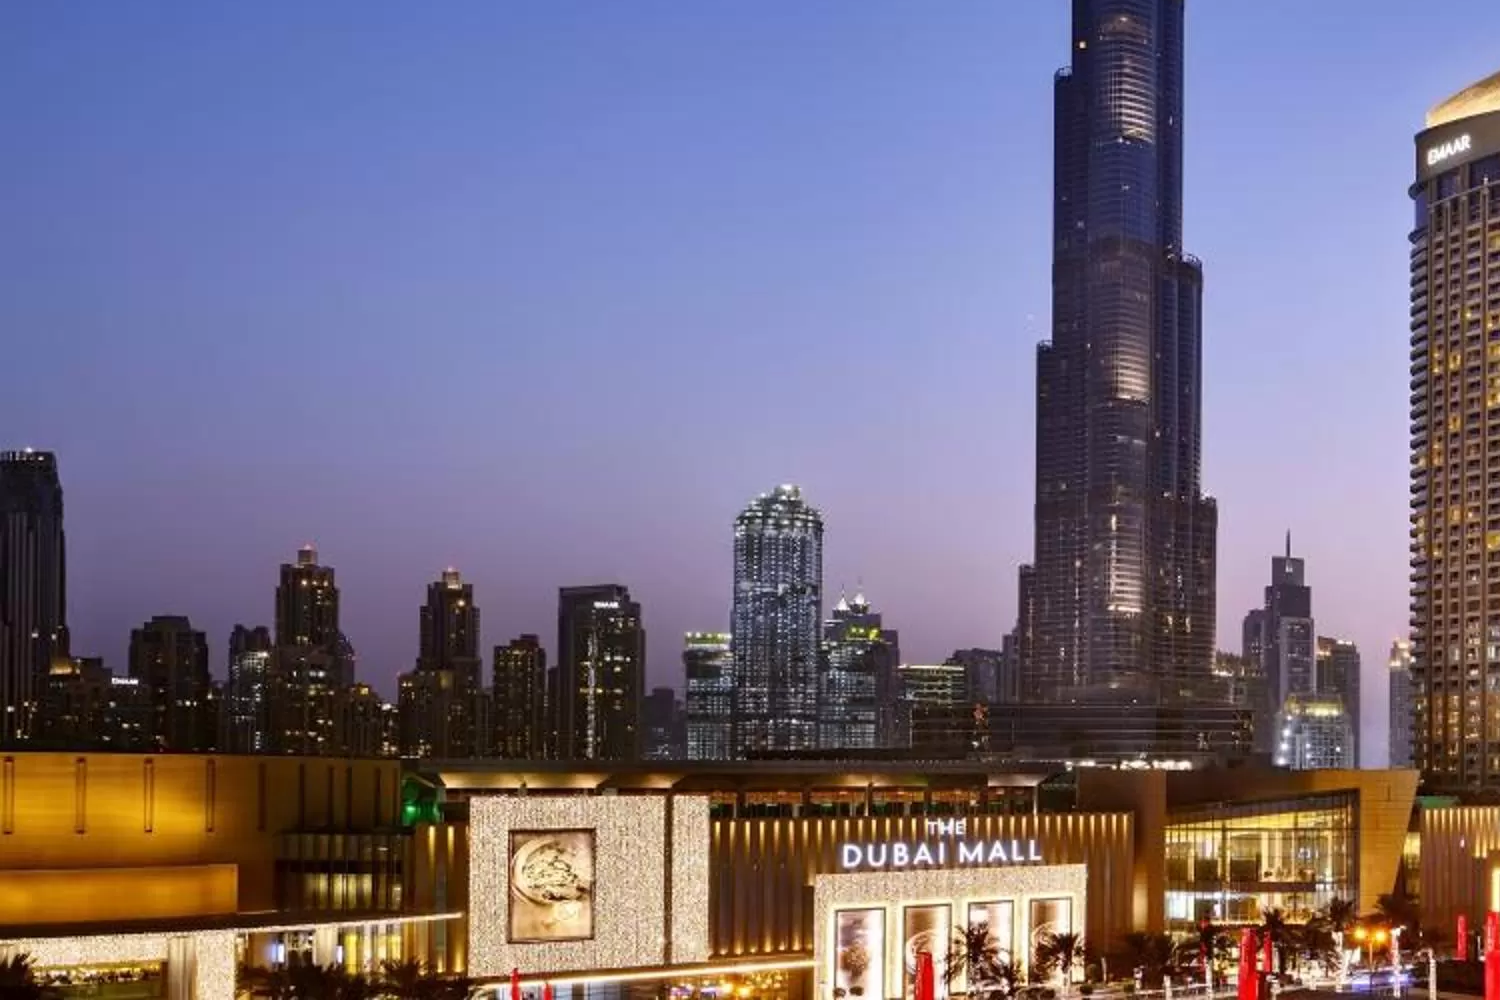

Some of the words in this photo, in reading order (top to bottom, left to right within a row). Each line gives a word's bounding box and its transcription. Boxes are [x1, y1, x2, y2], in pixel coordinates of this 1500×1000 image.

[1427, 134, 1471, 164] EMAAR
[927, 820, 966, 835] THE
[842, 842, 945, 868] DUBAI
[959, 839, 1042, 863] MALL
